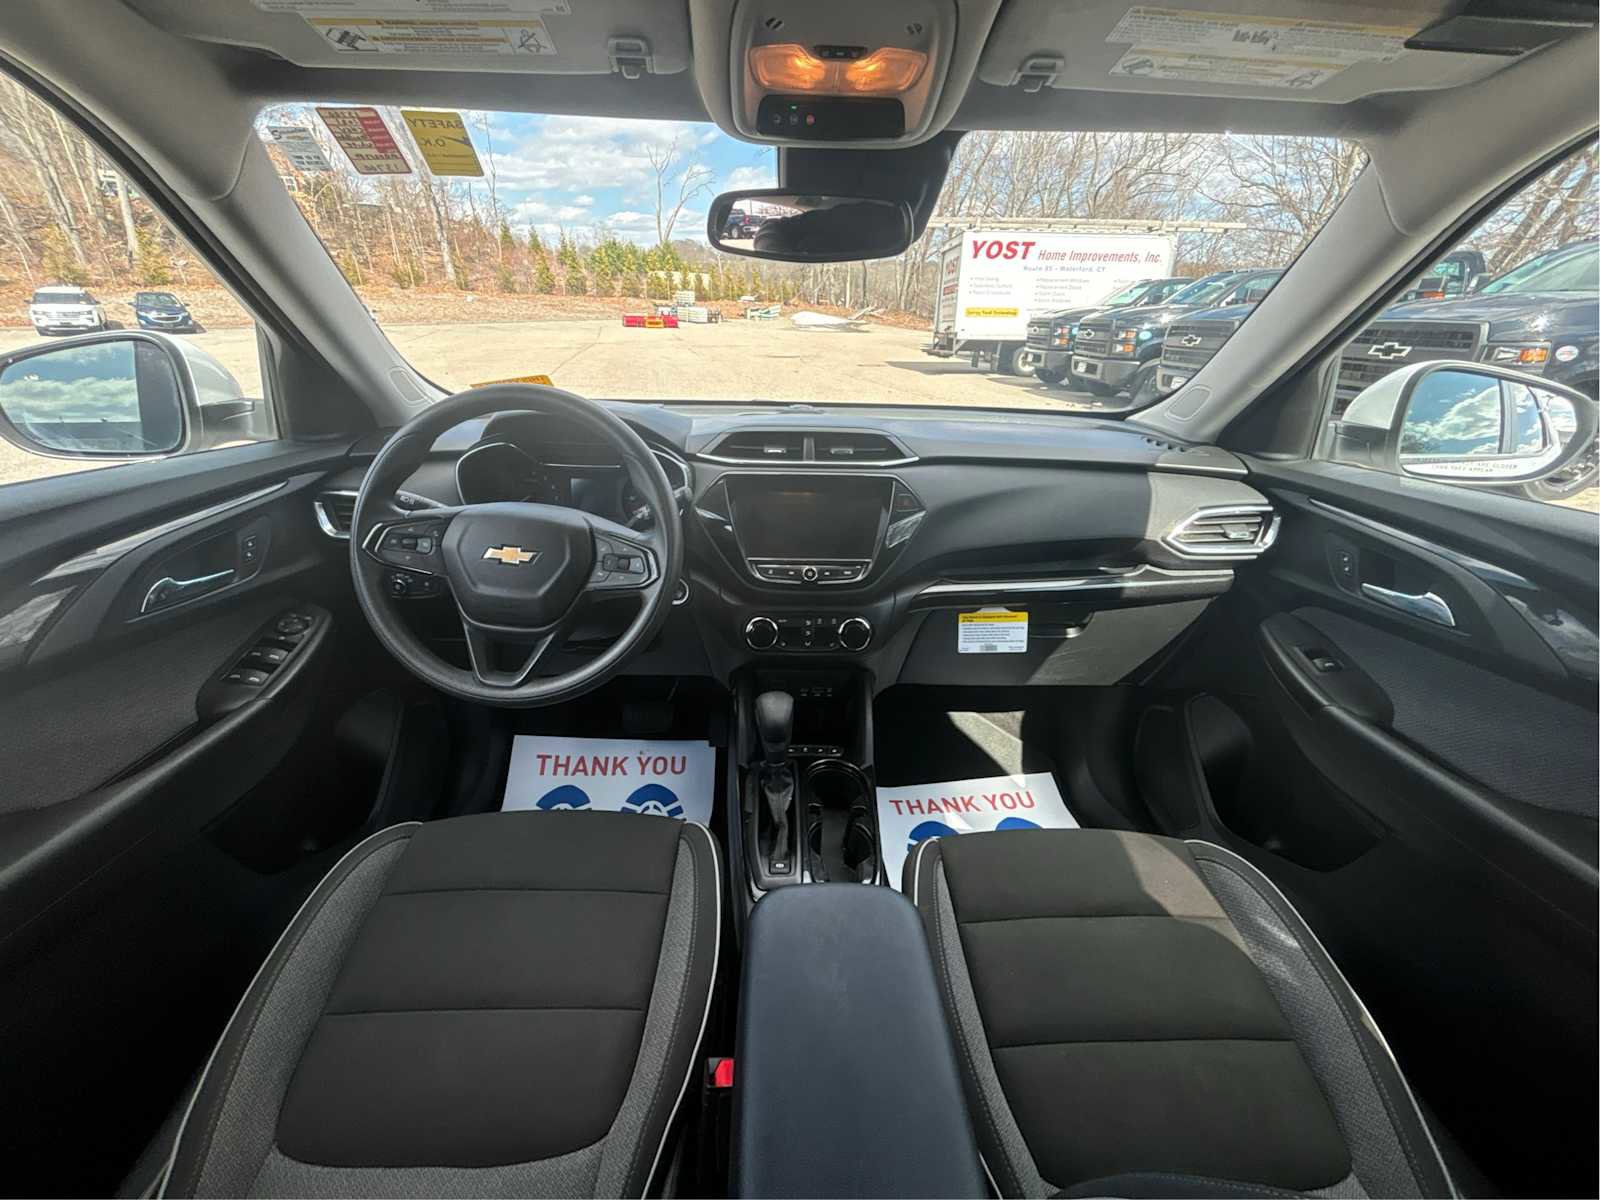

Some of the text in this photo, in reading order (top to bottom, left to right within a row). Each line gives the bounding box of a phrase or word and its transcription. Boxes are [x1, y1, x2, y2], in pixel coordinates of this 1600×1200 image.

[971, 240, 1163, 264] YOST Home Improvements, Inc.
[536, 754, 687, 776] THANK YOU
[889, 791, 1036, 816] THANK YOU
